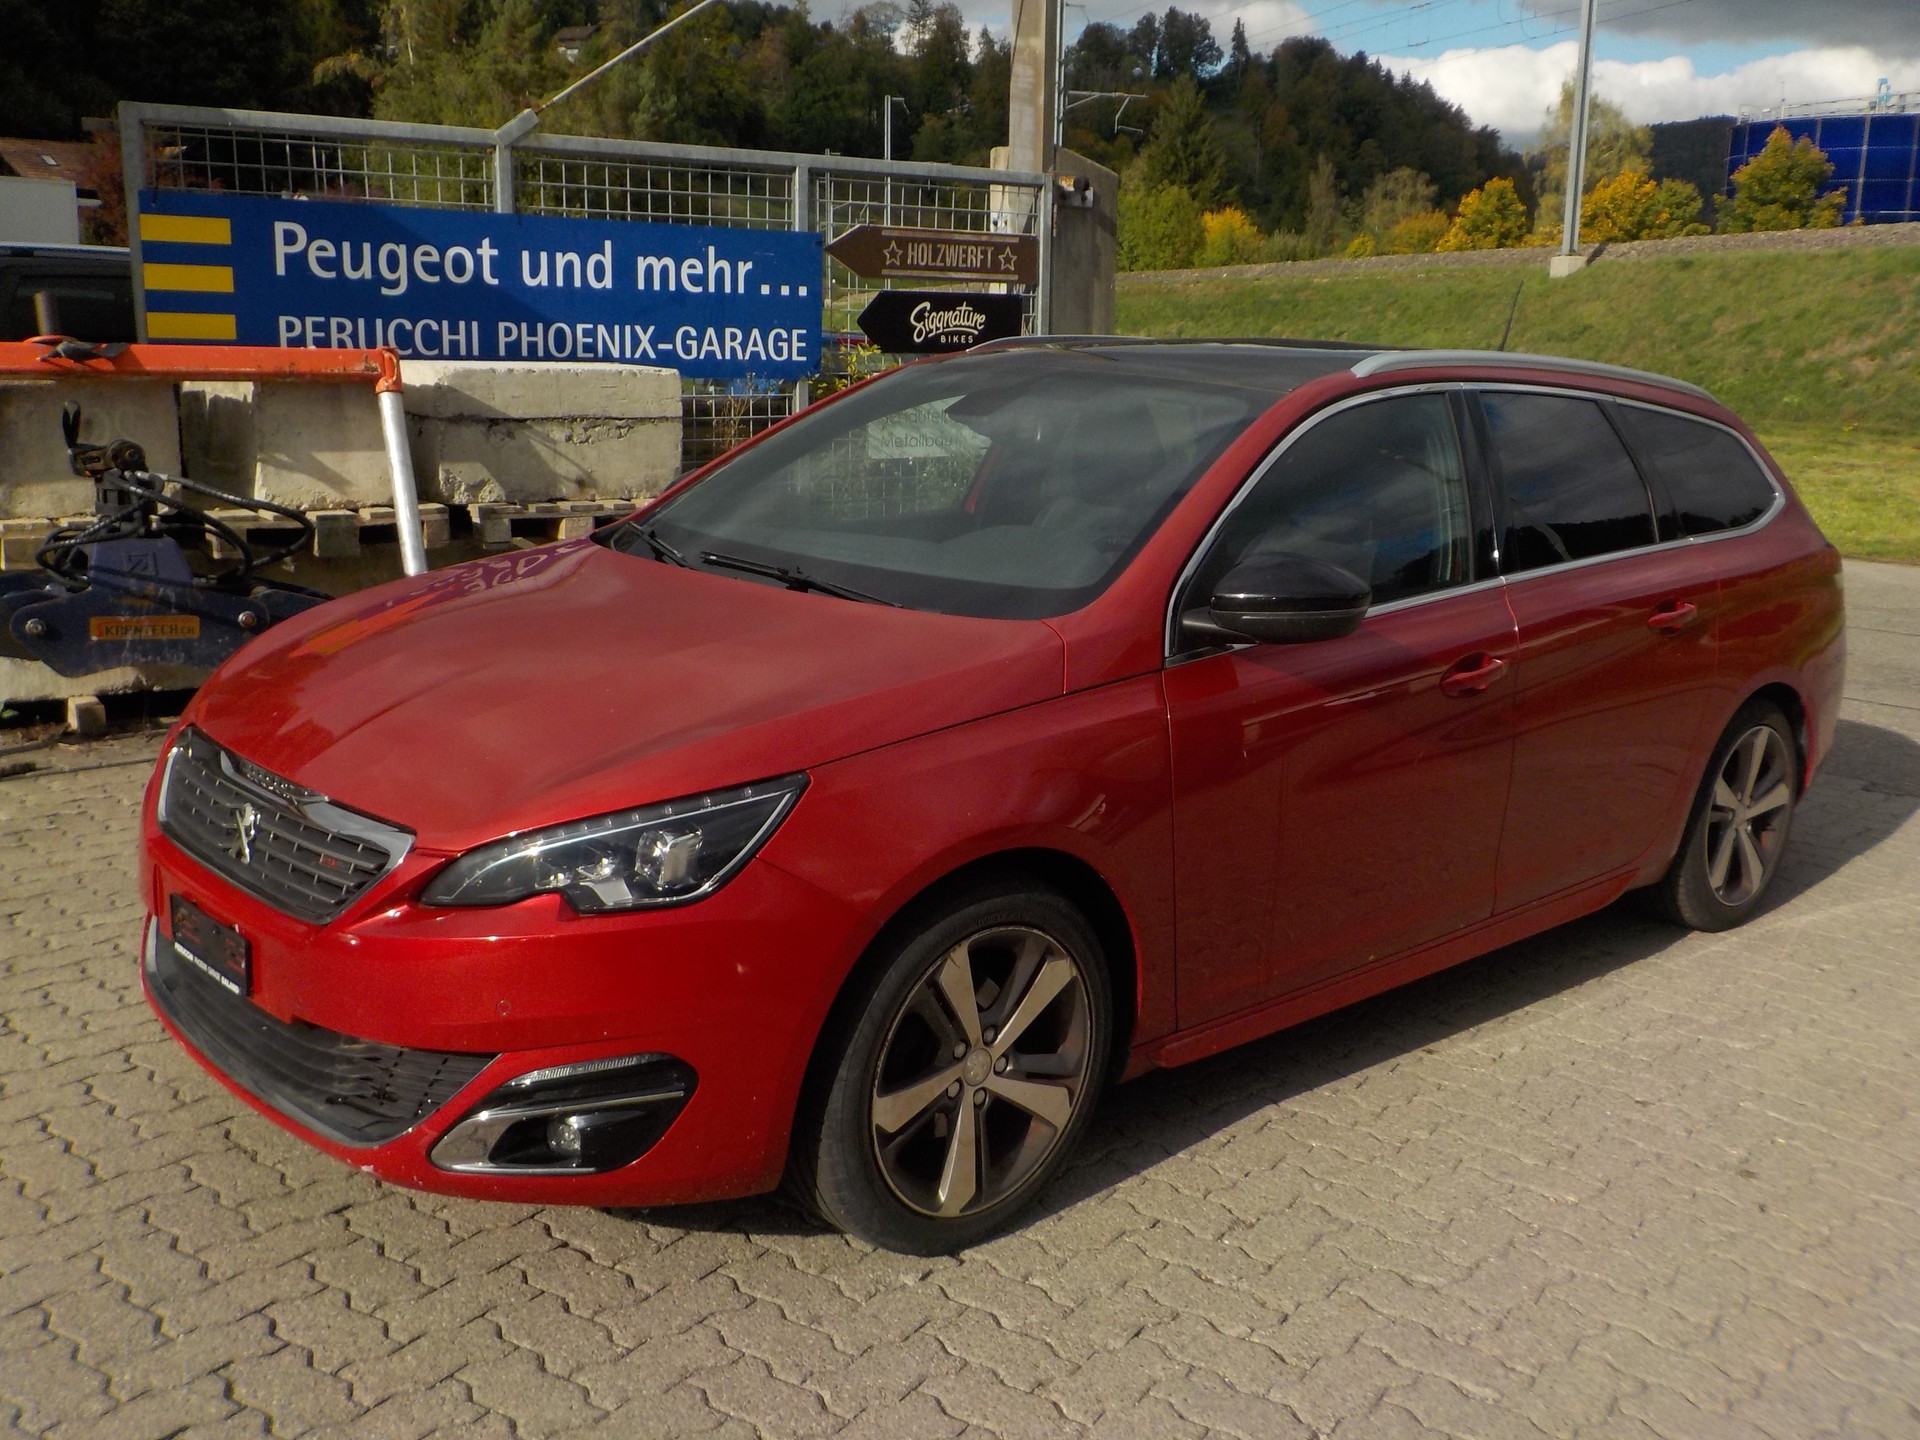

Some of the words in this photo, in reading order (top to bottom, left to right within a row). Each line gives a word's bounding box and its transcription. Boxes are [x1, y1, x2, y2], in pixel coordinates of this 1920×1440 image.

[274, 221, 499, 296] Peugeot
[522, 240, 613, 289] und
[637, 245, 807, 296] mehr...
[907, 241, 995, 269] HOLZWERFT
[278, 315, 480, 356] PERUCCHI
[498, 321, 808, 361] PHOENIX-GARAGE
[910, 301, 986, 344] Siggnature
[940, 334, 974, 344] BIKES
[880, 433, 953, 448] Metallbau
